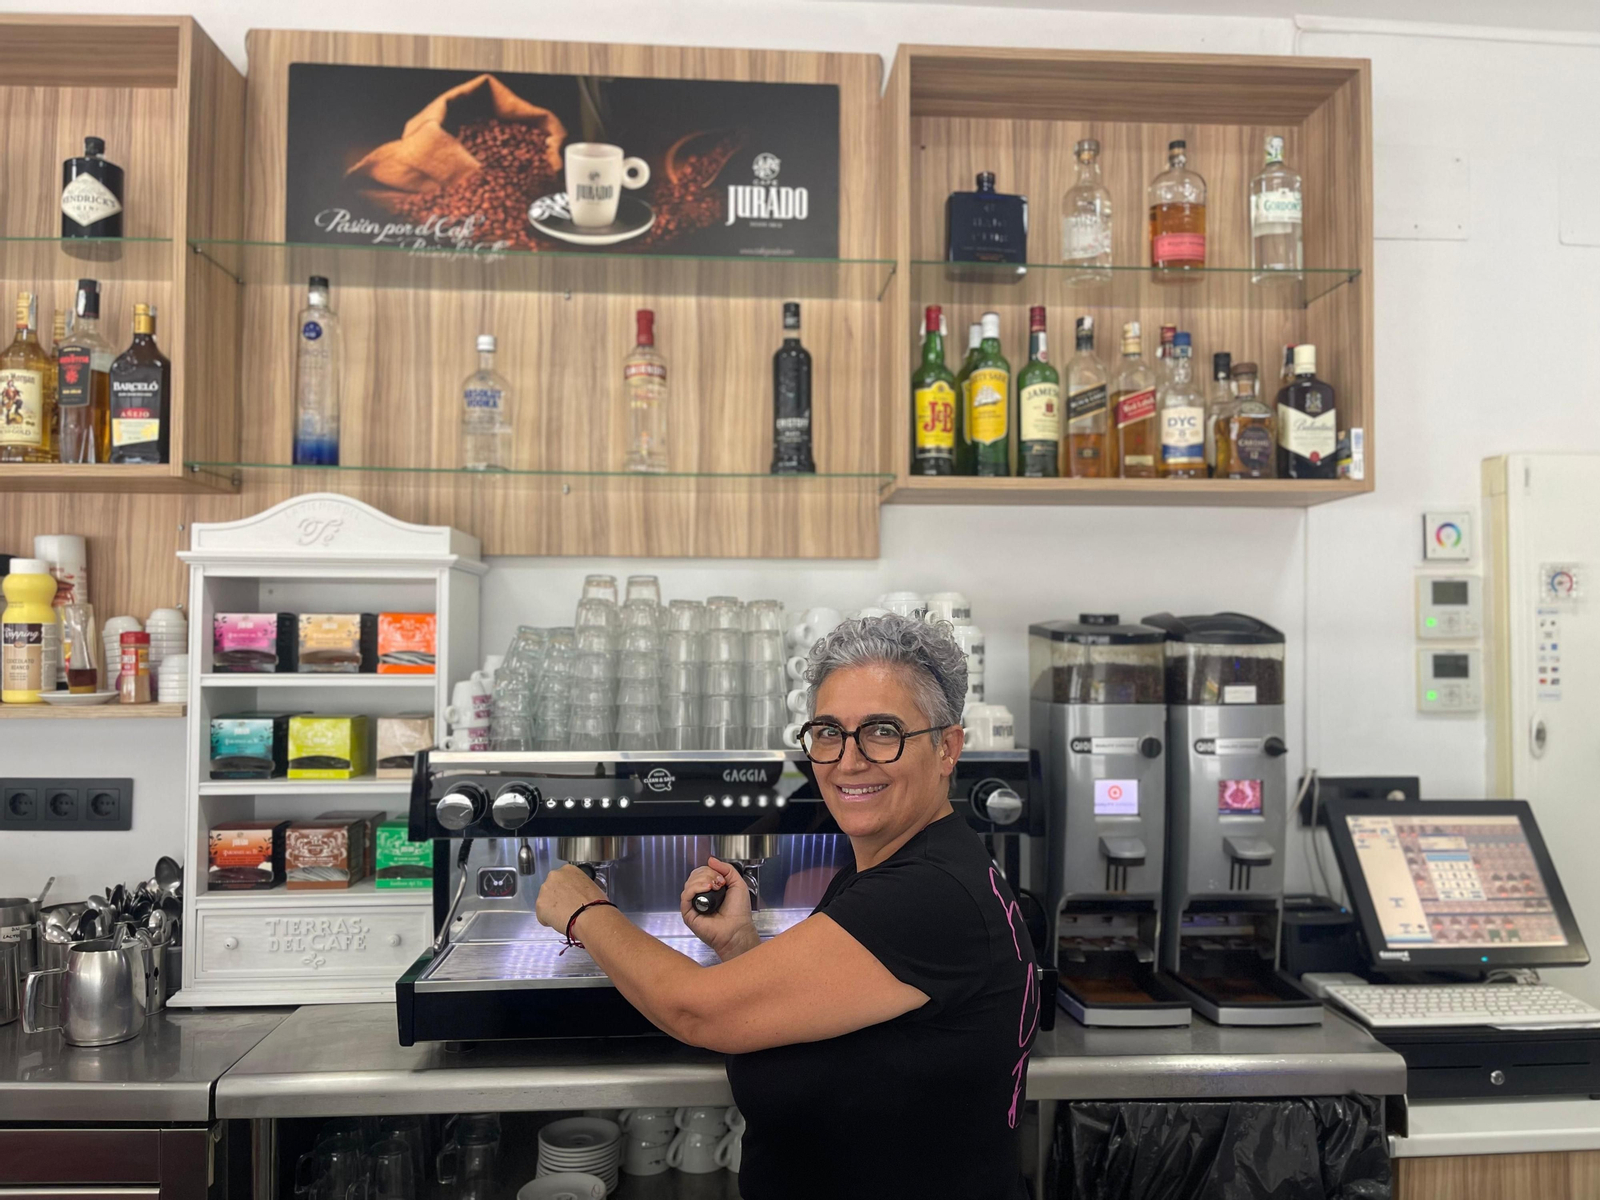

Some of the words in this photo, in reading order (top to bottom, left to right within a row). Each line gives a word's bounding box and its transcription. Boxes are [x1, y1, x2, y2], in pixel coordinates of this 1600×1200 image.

[725, 185, 808, 226] JURADO
[314, 207, 381, 235] Pasión
[371, 221, 415, 244] por
[113, 381, 159, 392] BARCELÓ
[120, 410, 150, 418] AÑEJO
[1167, 416, 1197, 427] DYC
[4, 627, 40, 642] Topping
[722, 769, 768, 783] GAGGIA
[265, 918, 363, 937] TIERRAS
[267, 936, 306, 953] DEL
